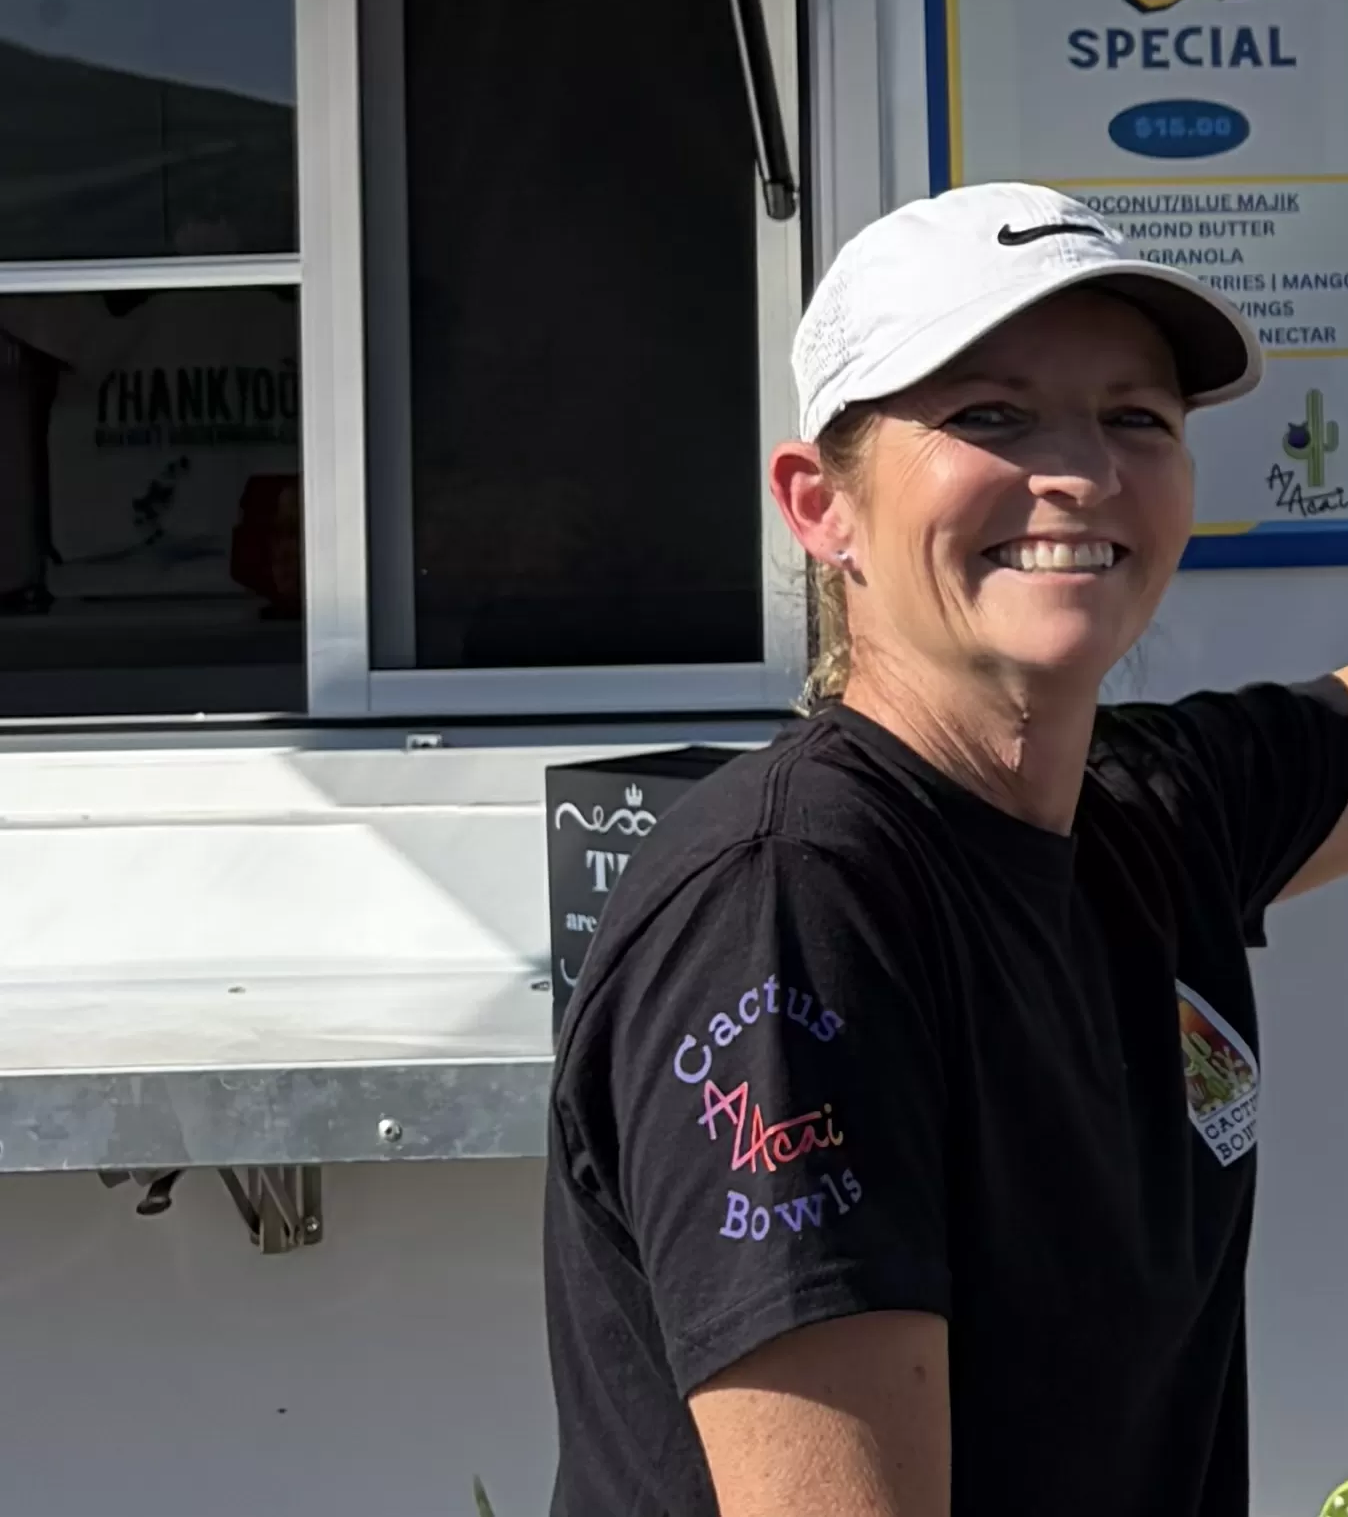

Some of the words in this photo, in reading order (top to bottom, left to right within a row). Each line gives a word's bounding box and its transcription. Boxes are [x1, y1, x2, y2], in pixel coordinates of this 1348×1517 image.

[1068, 27, 1296, 71] SPECIAL
[1238, 193, 1300, 211] MAJIK
[1200, 221, 1275, 237] BUTTER
[1259, 327, 1336, 343] NECTAR
[674, 974, 846, 1083] Cactus
[719, 1169, 862, 1241] Bowls
